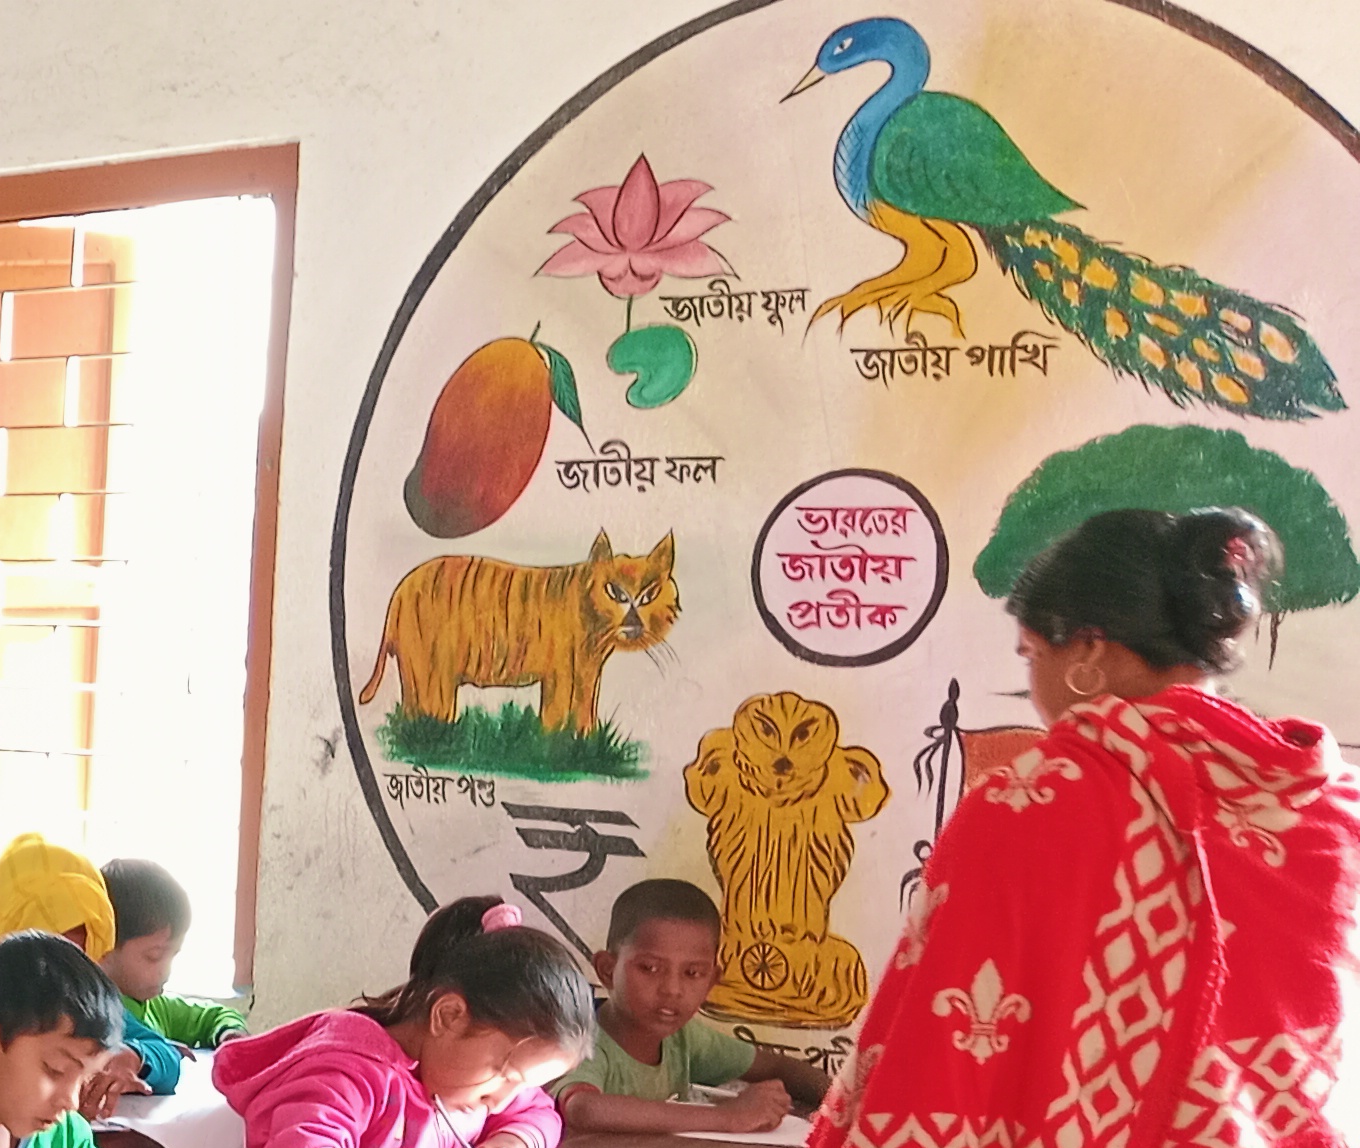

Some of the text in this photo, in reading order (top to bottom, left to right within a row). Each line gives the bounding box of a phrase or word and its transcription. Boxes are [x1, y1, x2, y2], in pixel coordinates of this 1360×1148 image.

[659, 278, 757, 328] জাতীয়
[849, 332, 1061, 388] জাতীয় পাখি
[555, 440, 726, 493] জাতীয় ফল
[795, 505, 917, 539] ভারতের
[777, 540, 917, 584] জাতীয়
[786, 588, 908, 631] প্রতীক
